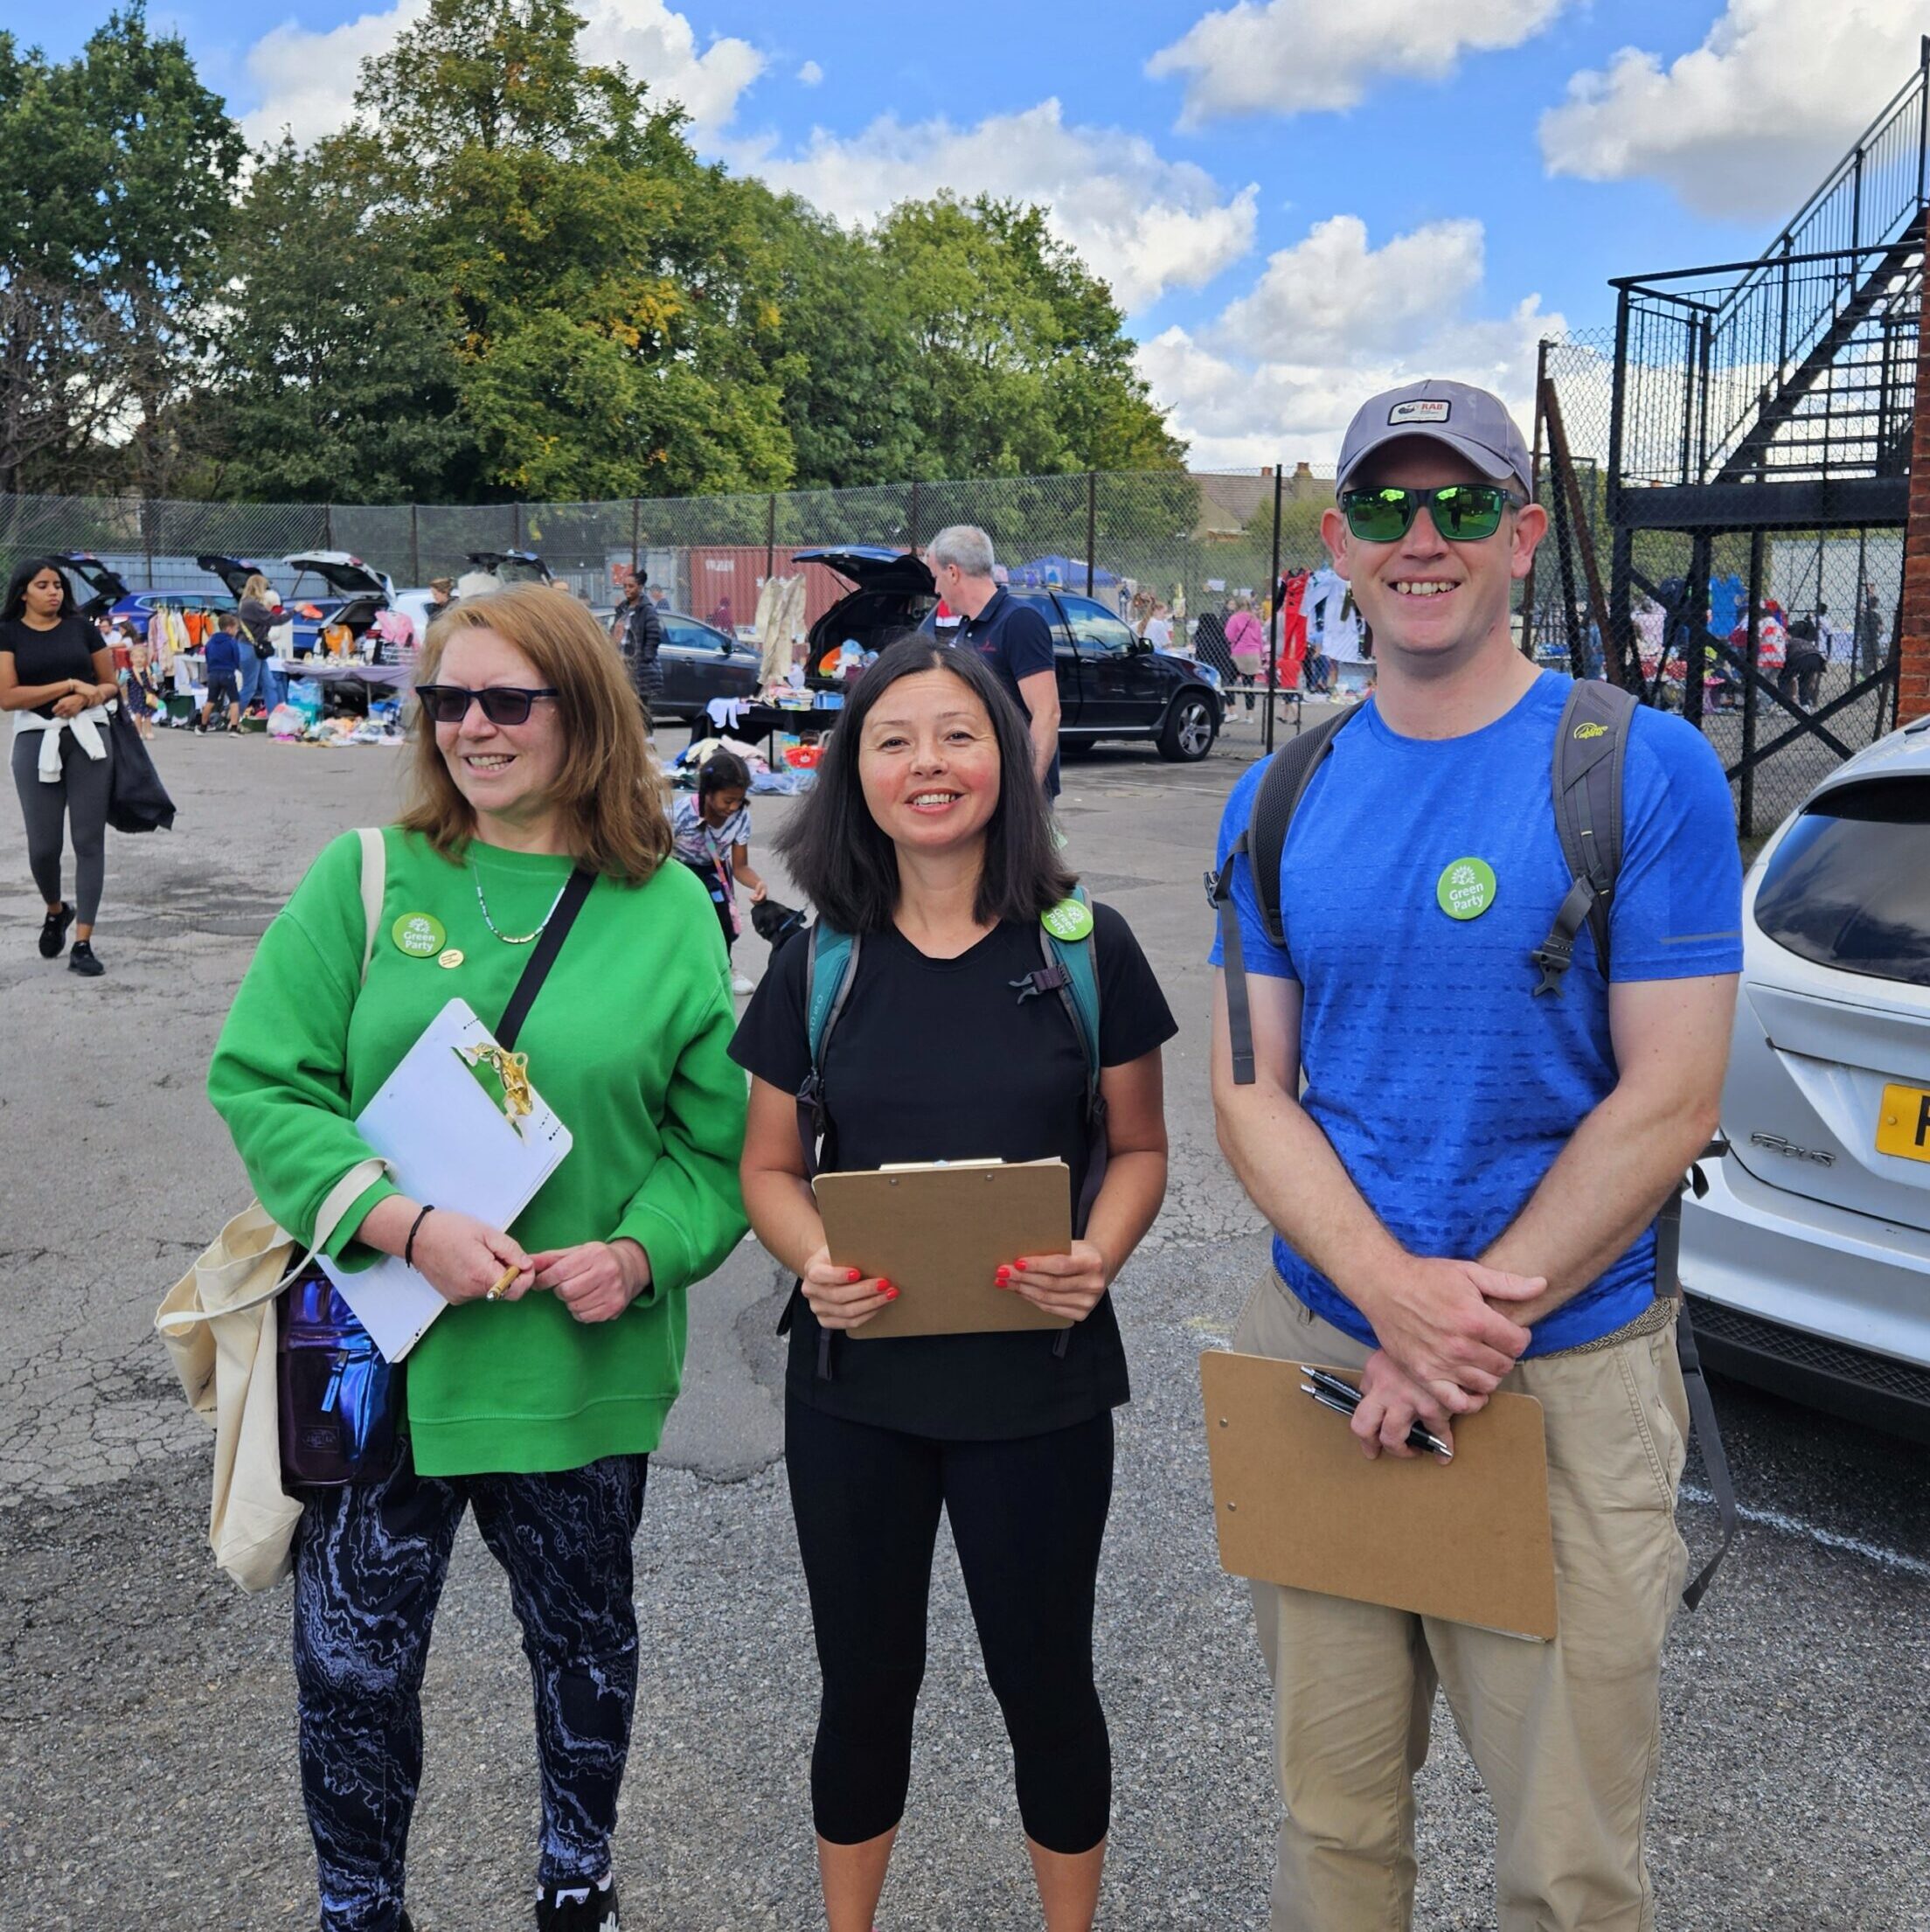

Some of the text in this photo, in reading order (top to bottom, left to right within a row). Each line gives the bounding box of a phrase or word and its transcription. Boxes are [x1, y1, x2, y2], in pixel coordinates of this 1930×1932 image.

[1449, 883, 1484, 900] Green
[1454, 894, 1483, 912] Party
[1046, 913, 1068, 935] Party
[1053, 908, 1076, 932] Green
[403, 931, 435, 942] Green
[405, 940, 434, 952] Party
